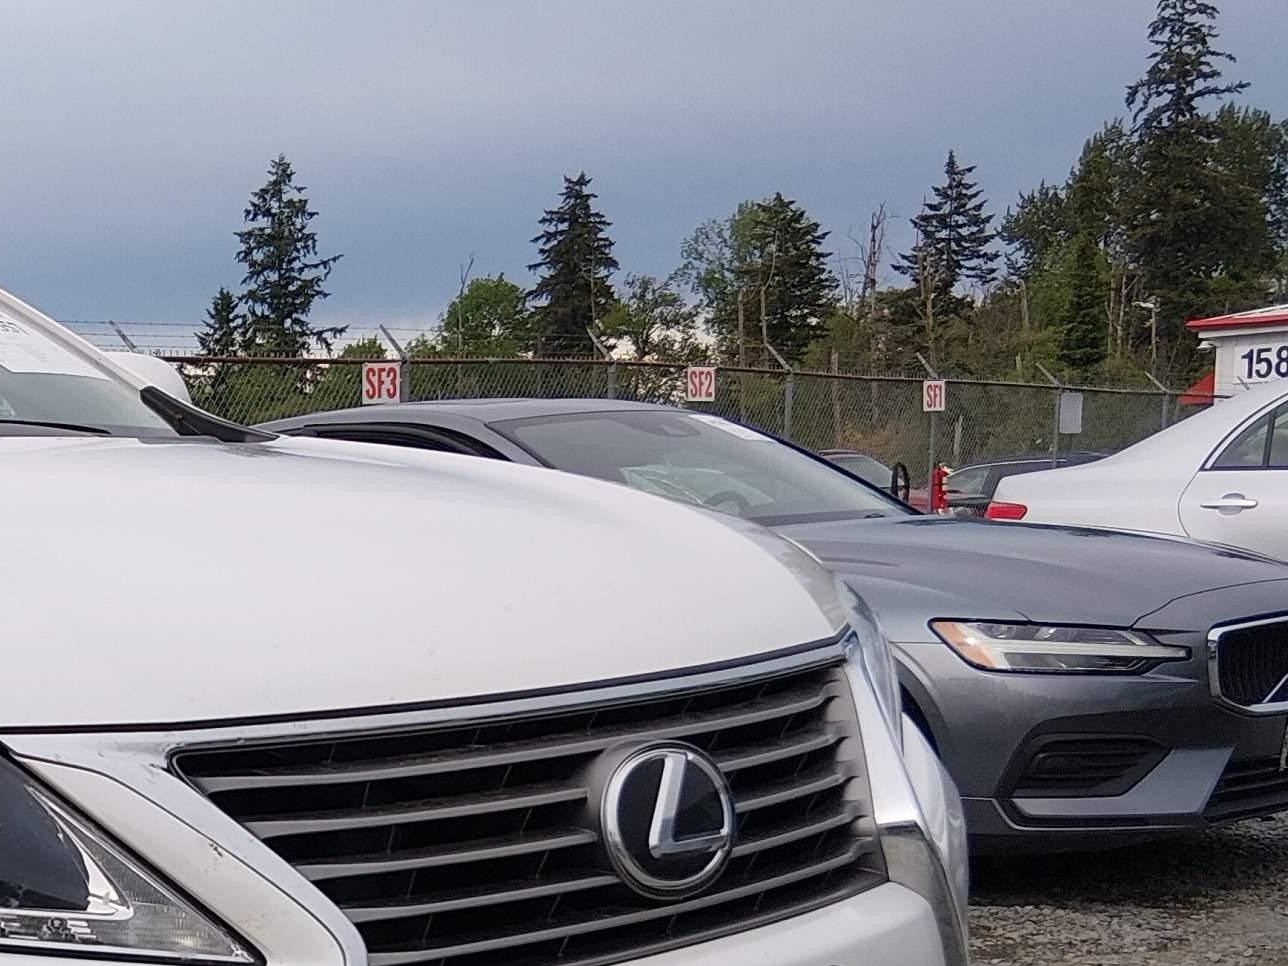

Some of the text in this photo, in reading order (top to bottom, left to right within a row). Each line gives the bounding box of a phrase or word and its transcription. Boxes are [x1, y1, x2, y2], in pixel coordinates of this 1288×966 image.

[365, 366, 397, 400] SF3
[689, 370, 713, 398] SF2
[926, 384, 943, 409] SF1
